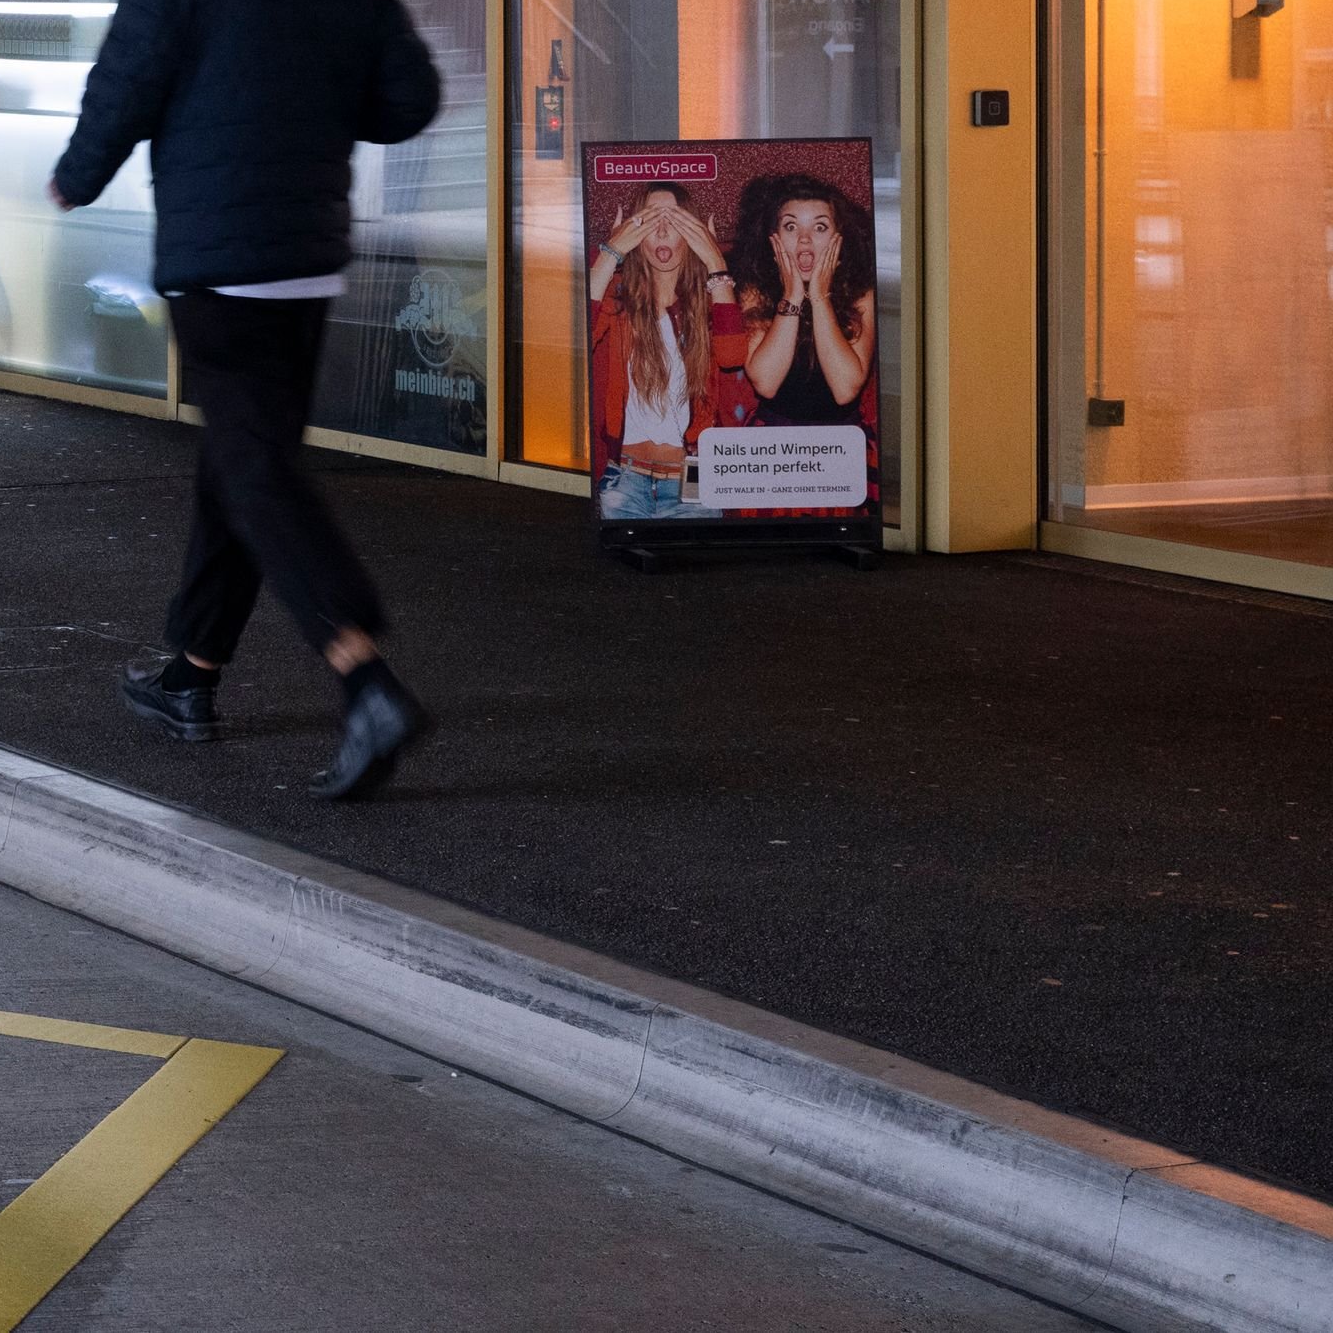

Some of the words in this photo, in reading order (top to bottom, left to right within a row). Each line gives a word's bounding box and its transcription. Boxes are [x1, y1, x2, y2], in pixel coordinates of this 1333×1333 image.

[604, 162, 706, 177] BeautySpace
[395, 368, 475, 402] meinbier.ch
[714, 444, 746, 456] Nails
[750, 444, 776, 455] und
[781, 443, 847, 457] Wimpern,
[713, 463, 769, 476] spontan
[773, 461, 825, 475] perfekt.
